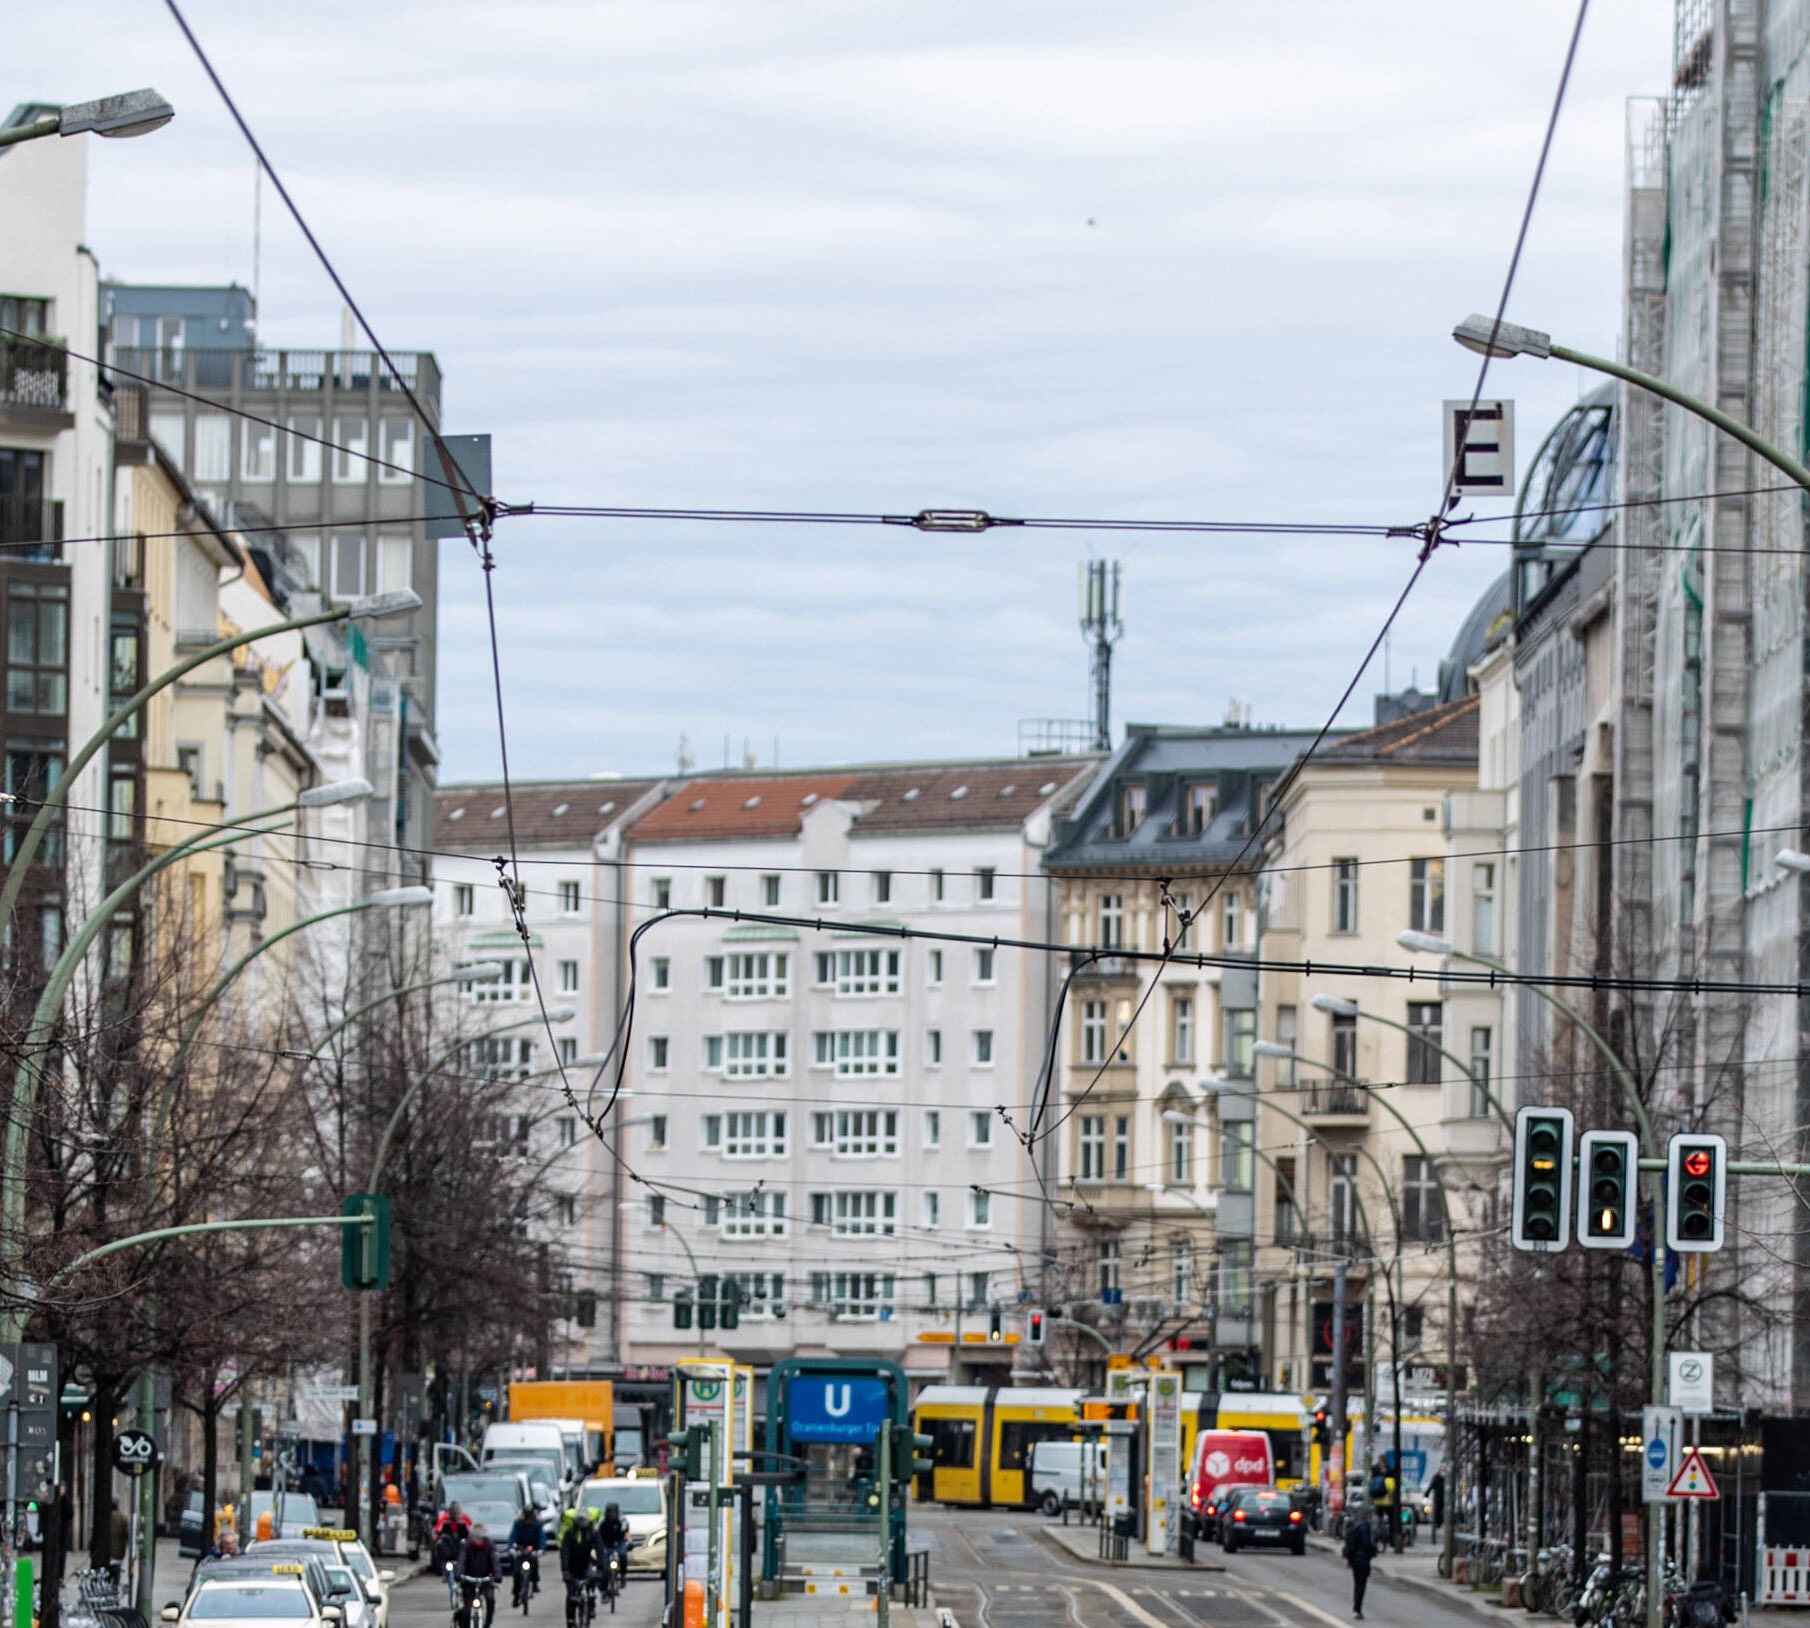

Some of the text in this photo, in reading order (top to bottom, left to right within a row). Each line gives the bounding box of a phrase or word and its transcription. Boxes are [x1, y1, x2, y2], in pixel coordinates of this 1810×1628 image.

[1454, 409, 1504, 486] E
[824, 1383, 852, 1418] U
[1234, 1457, 1265, 1476] dpd
